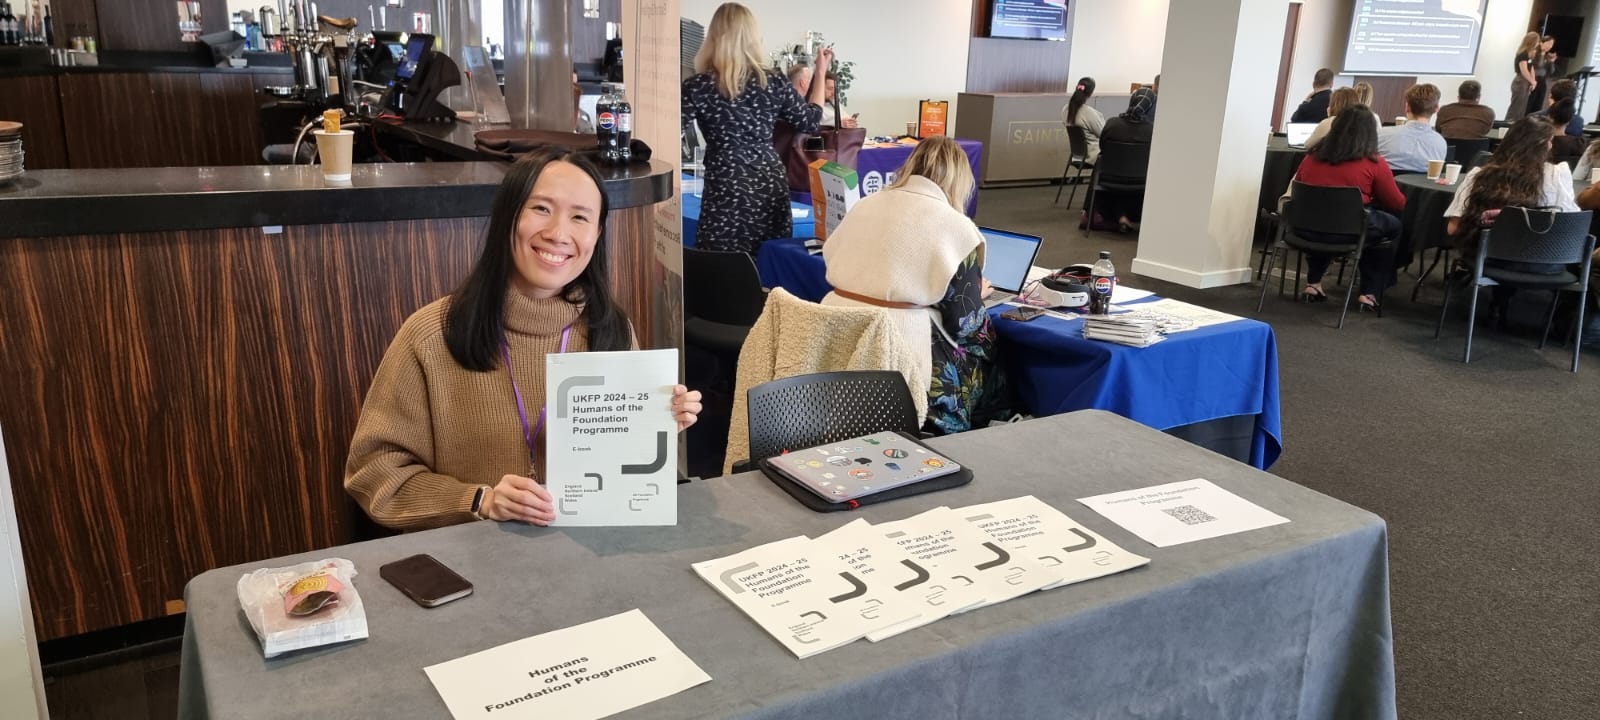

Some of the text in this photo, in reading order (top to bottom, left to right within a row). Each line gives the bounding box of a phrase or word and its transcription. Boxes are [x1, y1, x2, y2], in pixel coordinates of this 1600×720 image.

[572, 394, 601, 403] UKFP
[603, 393, 626, 402] 2024
[637, 392, 649, 401] 25
[572, 403, 643, 414] Humans of the
[572, 415, 628, 424] Foundation
[572, 426, 629, 436] Programme
[984, 524, 1018, 533] Humans
[738, 571, 765, 583] UKFP
[767, 563, 789, 574] 2024
[745, 573, 784, 588] Humans
[751, 573, 805, 593] Foundation
[758, 578, 812, 598] Programme
[528, 656, 589, 678] Humans
[544, 667, 588, 684] of the
[484, 656, 657, 713] Foundation Programme
